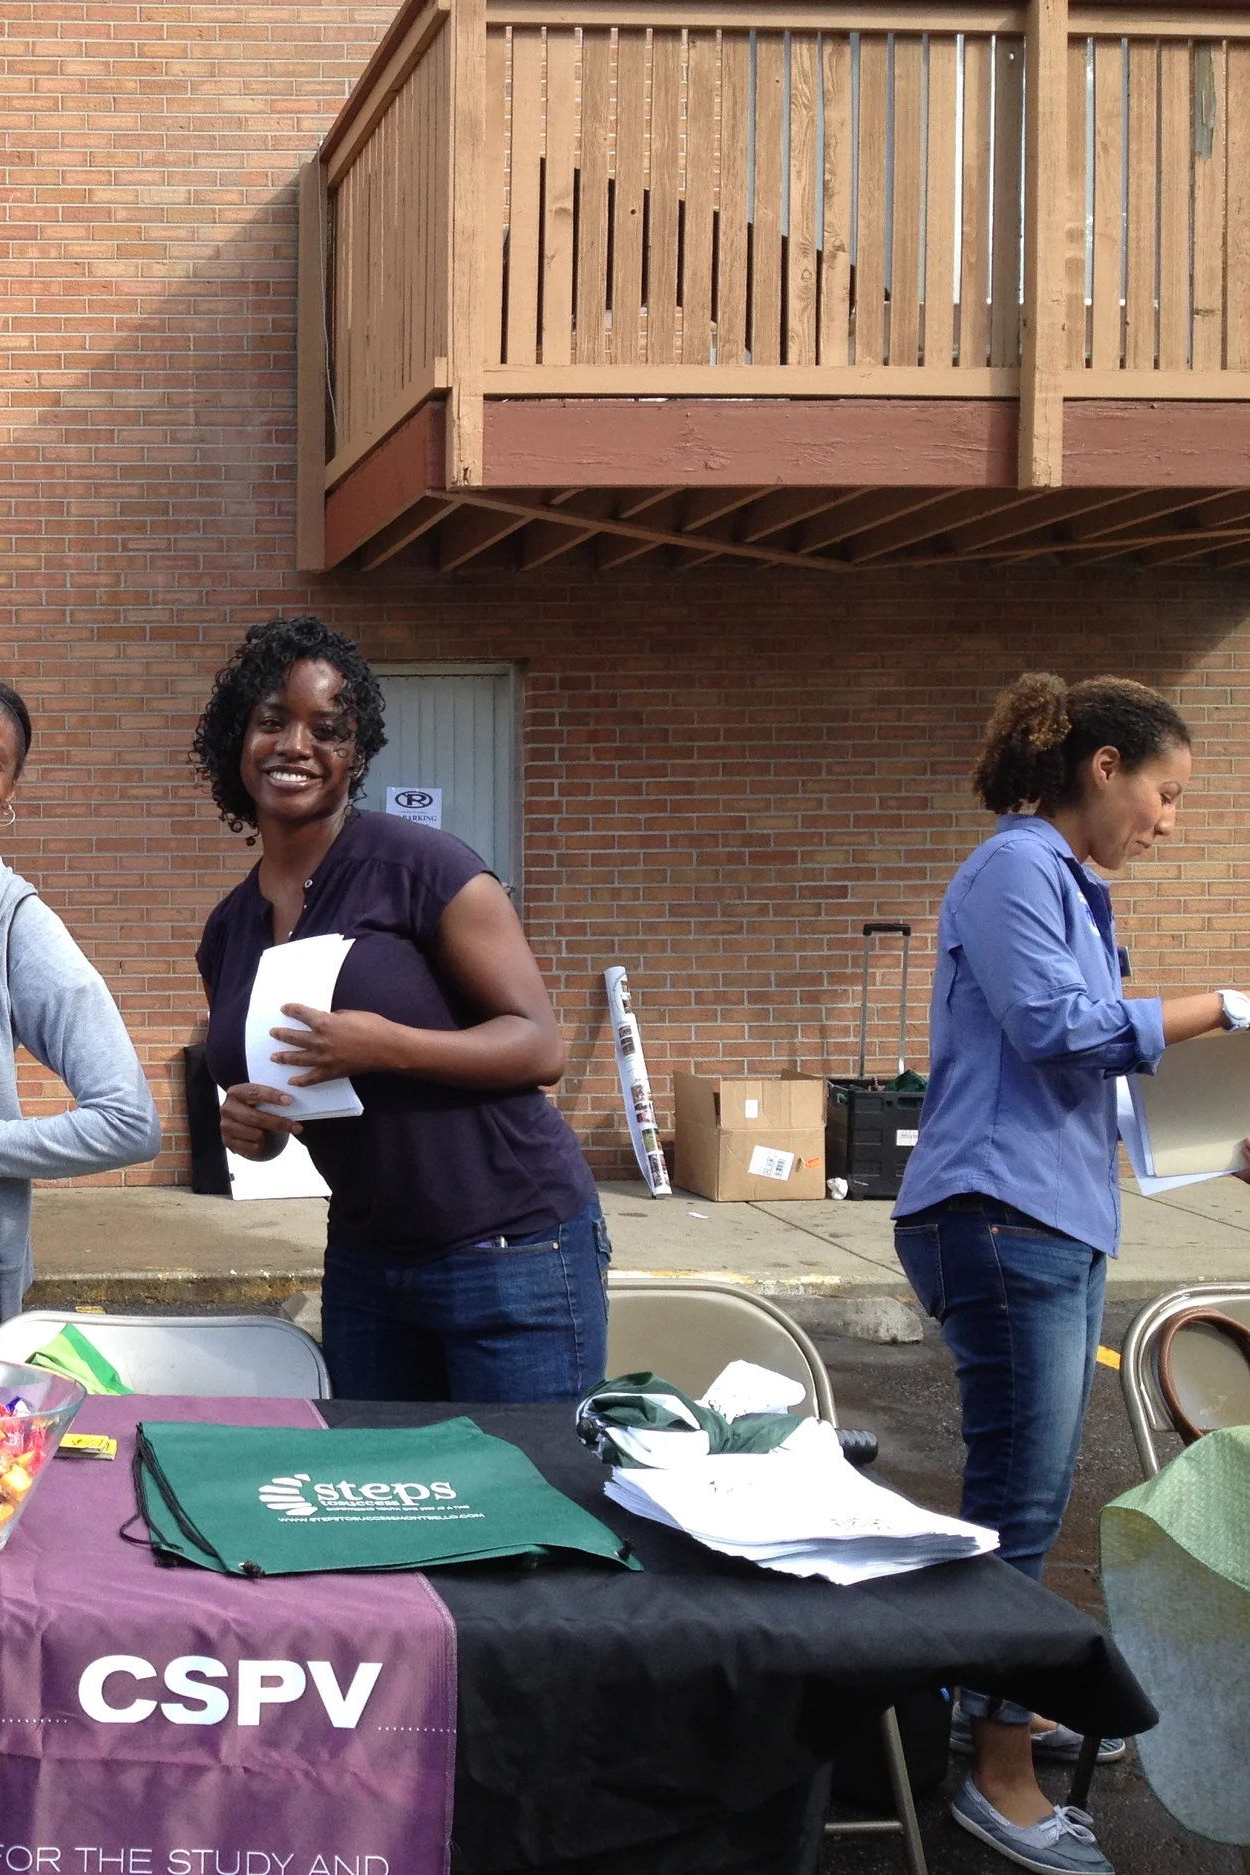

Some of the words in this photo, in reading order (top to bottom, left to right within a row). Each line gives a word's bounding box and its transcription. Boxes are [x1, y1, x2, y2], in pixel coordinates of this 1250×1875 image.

[313, 1480, 457, 1506] steps
[78, 1655, 383, 1729] CSPV
[74, 1846, 152, 1875] THE
[168, 1849, 295, 1875] STUDY
[308, 1853, 390, 1875] AND
